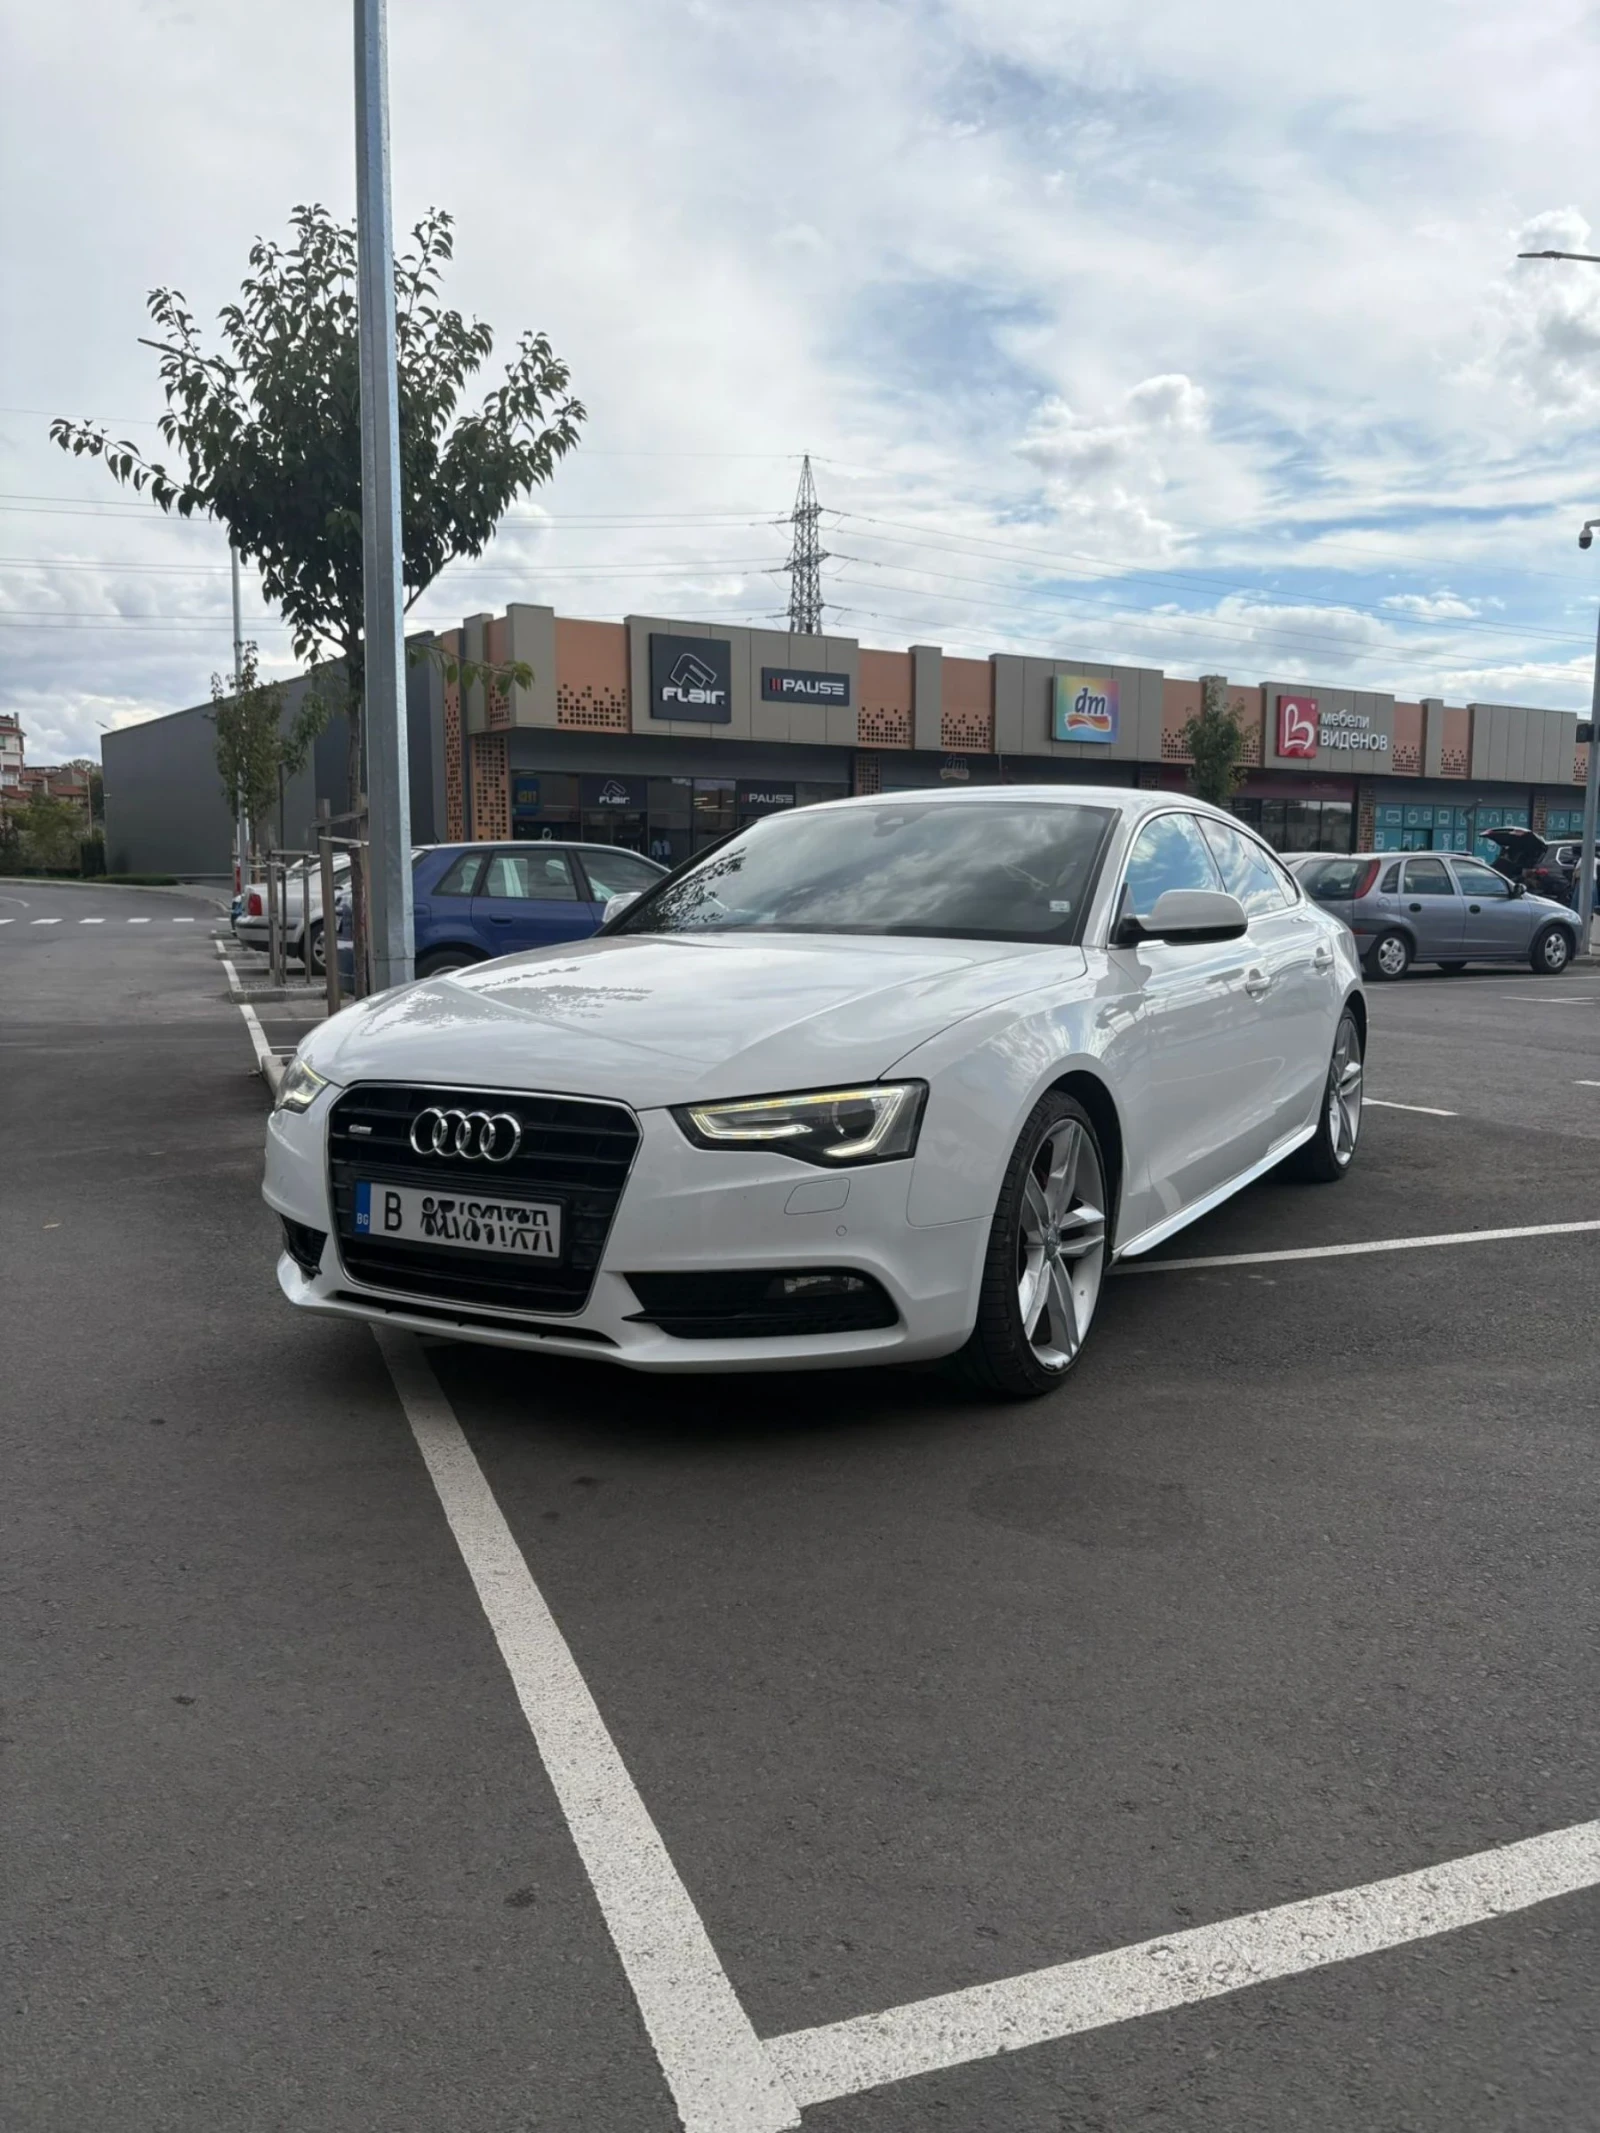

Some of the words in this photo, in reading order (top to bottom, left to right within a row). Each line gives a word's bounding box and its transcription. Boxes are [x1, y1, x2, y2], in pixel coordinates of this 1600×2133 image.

[782, 678, 845, 696] PAUSE
[1074, 686, 1106, 715] dm
[1320, 709, 1370, 729] мебели
[748, 793, 794, 804] PAUSE
[356, 1212, 369, 1226] BG
[384, 1191, 402, 1231] B
